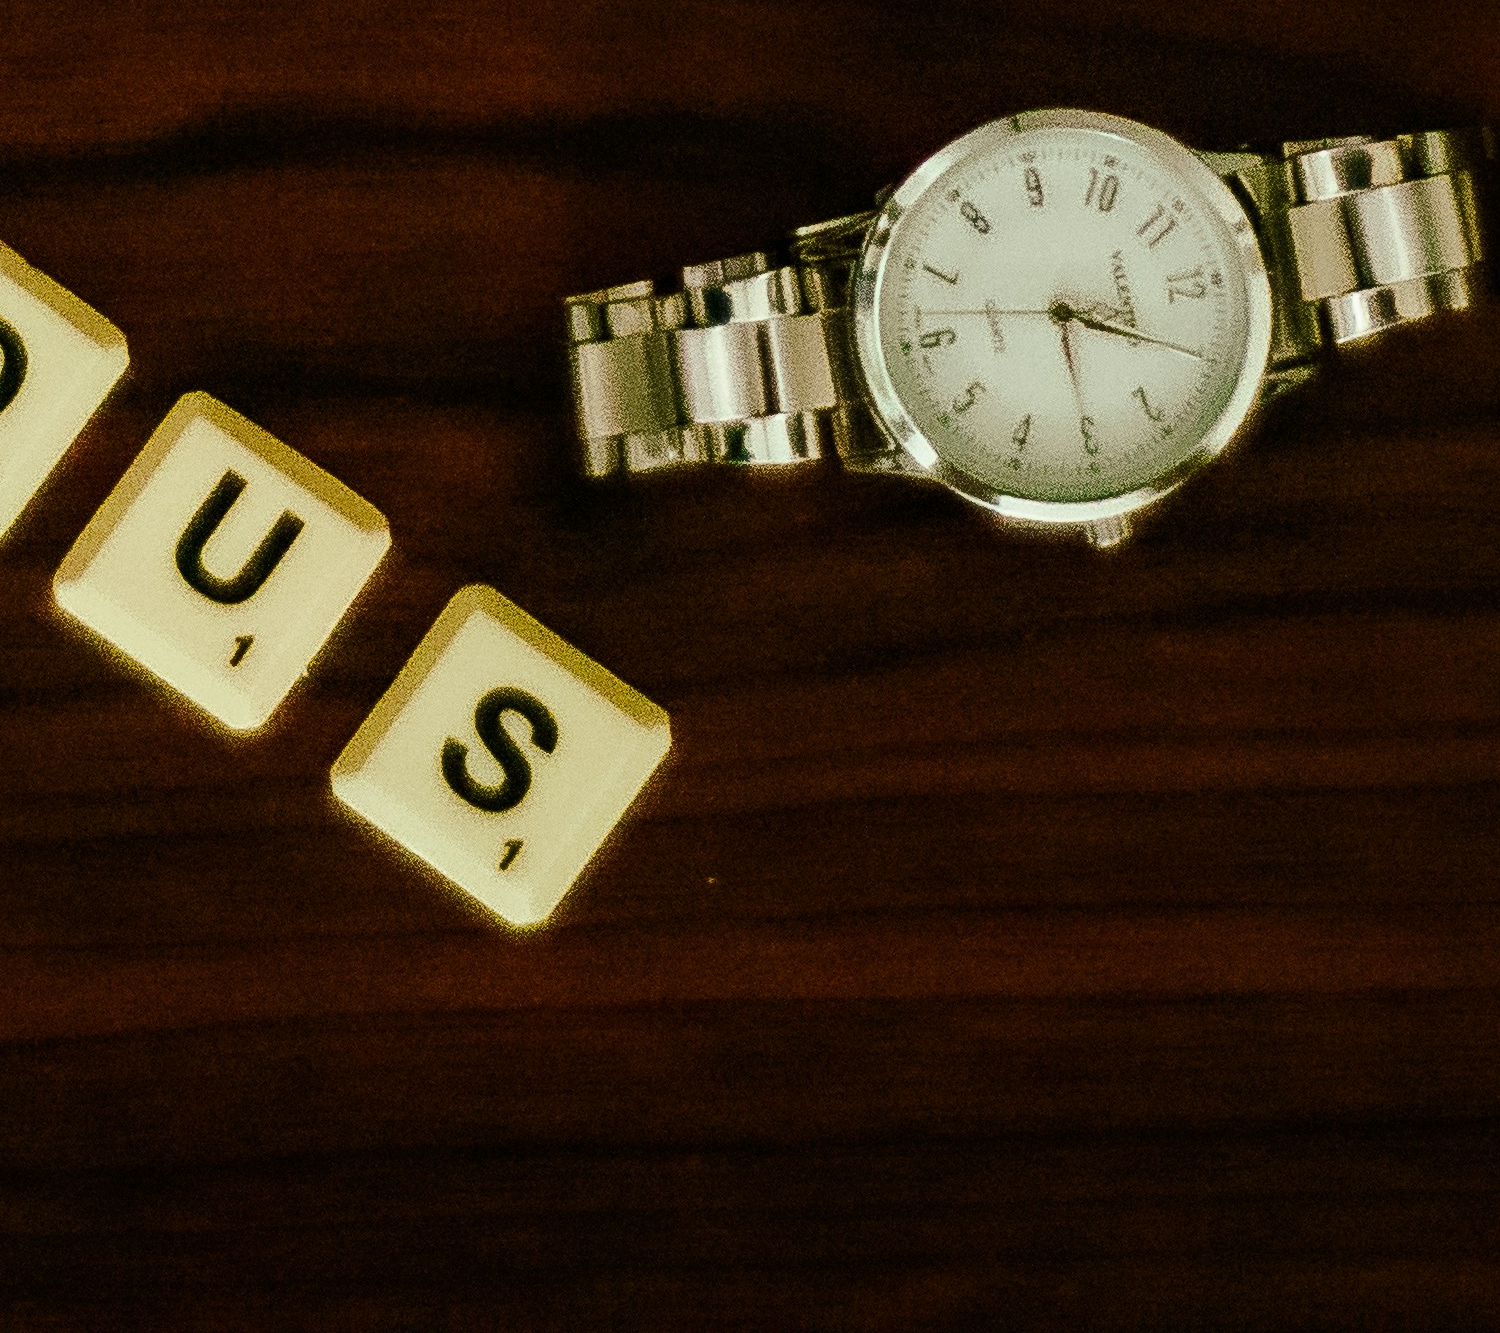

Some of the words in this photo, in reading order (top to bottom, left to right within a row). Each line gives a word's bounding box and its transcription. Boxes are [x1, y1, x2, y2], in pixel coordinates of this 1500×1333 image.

[1023, 167, 1044, 208] 9
[1085, 167, 1120, 213] 10
[960, 201, 990, 235] 8
[1136, 203, 1177, 248] 11
[921, 264, 959, 286] 7
[1166, 267, 1207, 305] 12
[919, 327, 957, 350] 6
[953, 381, 986, 414] 5
[1133, 386, 1164, 422] 2
[1012, 414, 1032, 453] 4
[1080, 415, 1100, 457] 3
[230, 637, 253, 666] 1
[500, 841, 522, 870] 1
